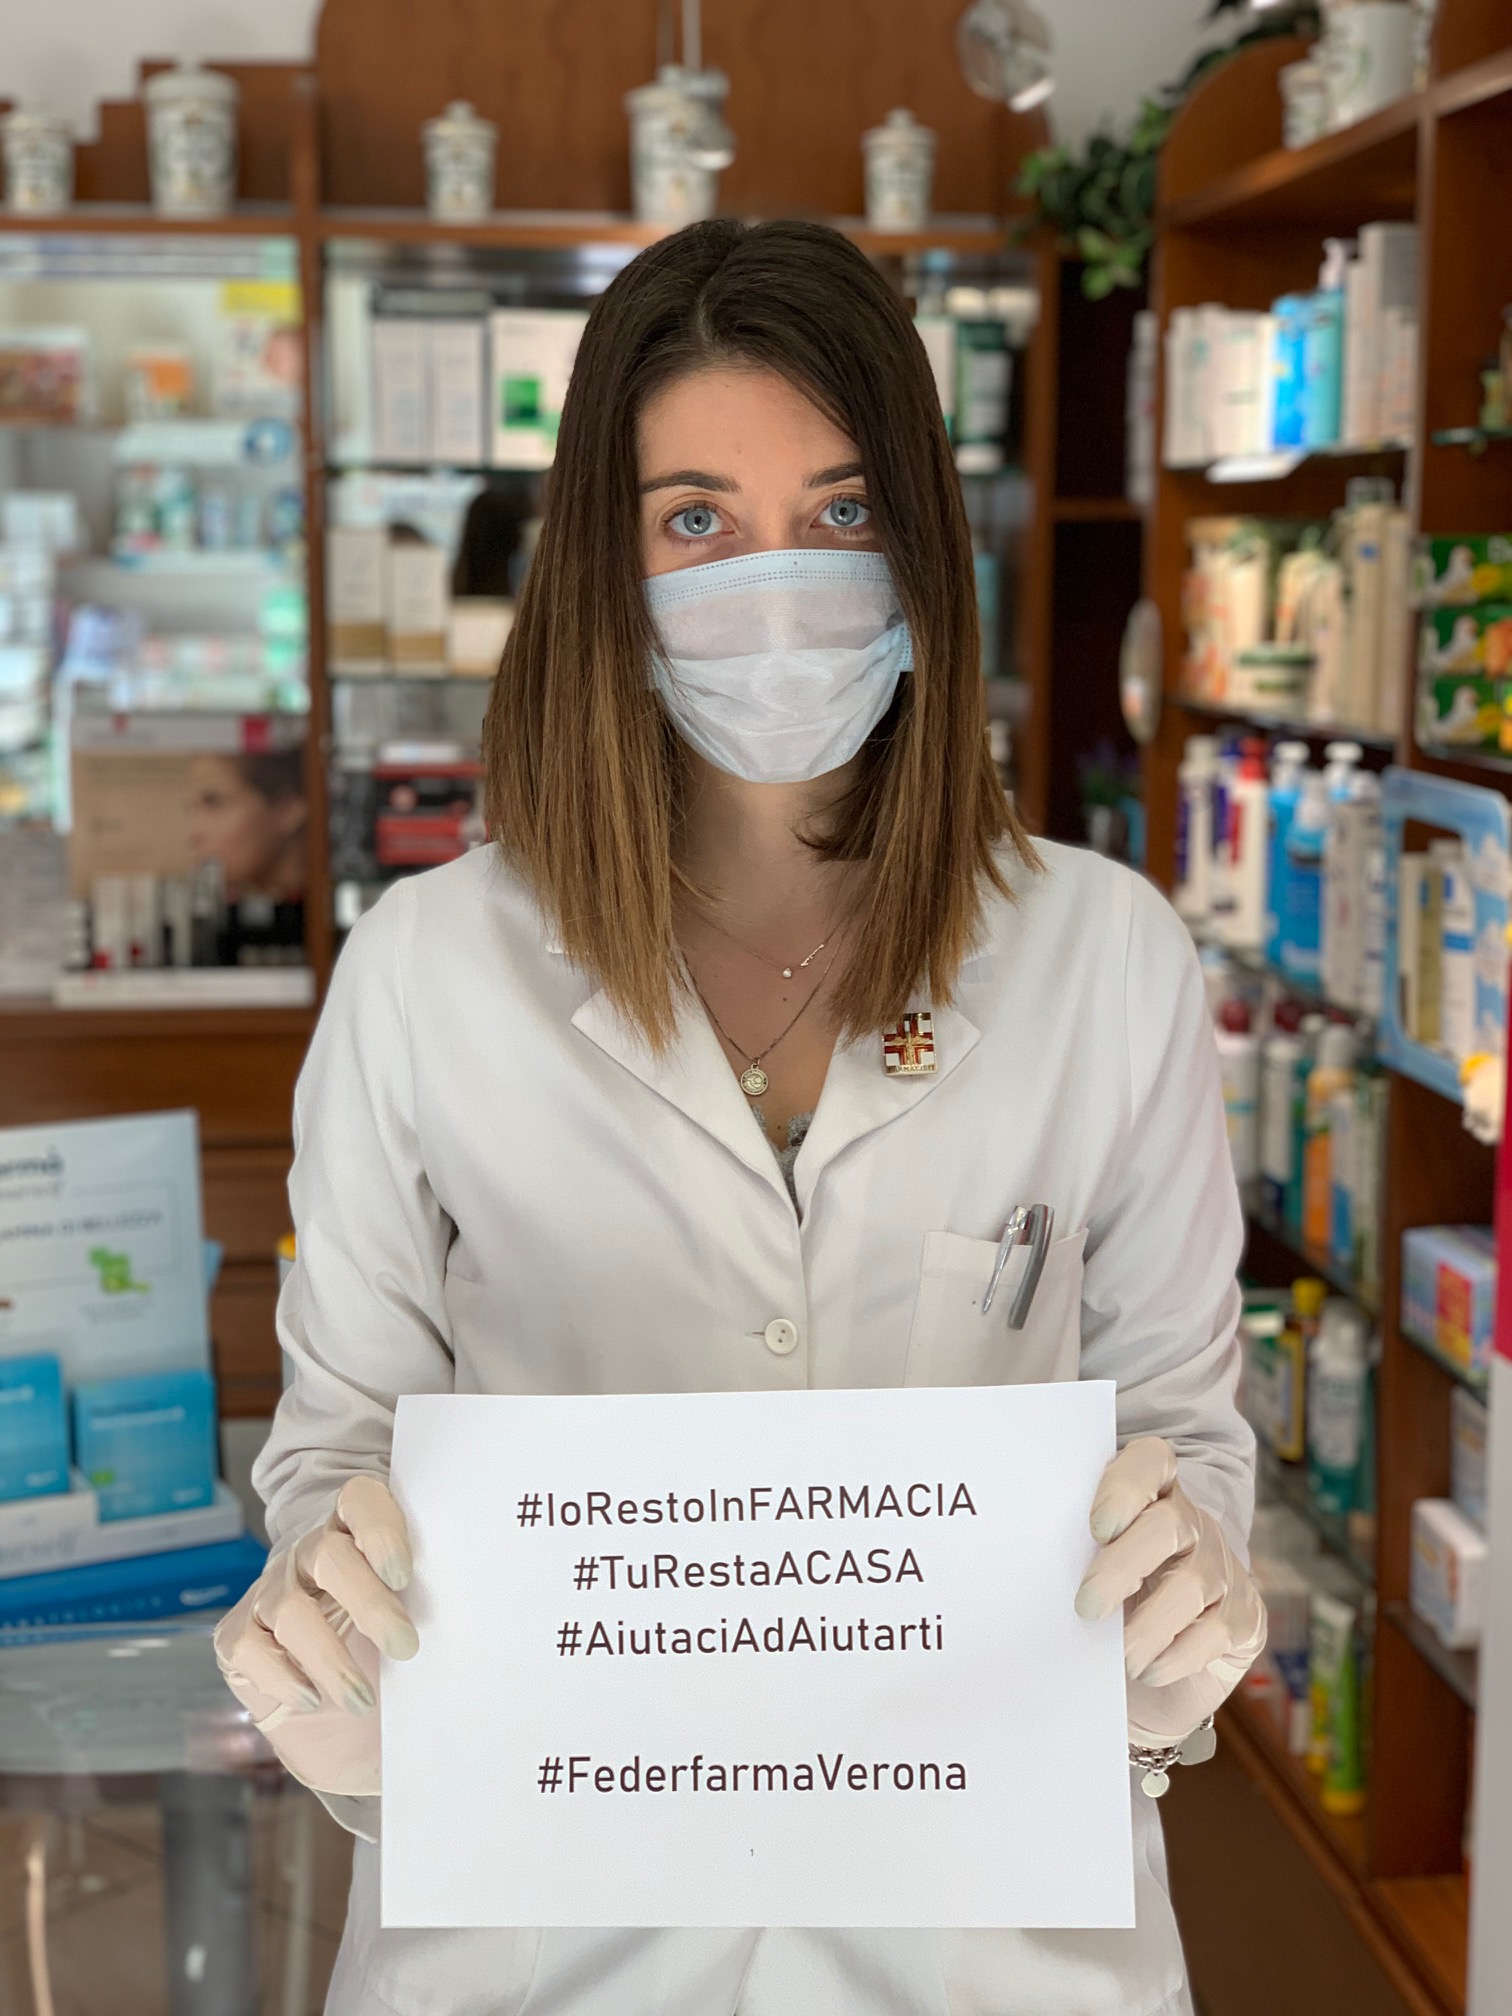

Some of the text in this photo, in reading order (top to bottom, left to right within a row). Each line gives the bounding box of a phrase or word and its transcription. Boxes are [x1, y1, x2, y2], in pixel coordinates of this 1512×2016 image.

[516, 1482, 977, 1527] #IoRestoInFARMACIA
[573, 1548, 924, 1591] #TuRestaACASA
[556, 1614, 943, 1657] #AiutaciAdAiutarti
[537, 1753, 966, 1794] #FederfarmaVerona
[749, 1848, 754, 1857] 1
